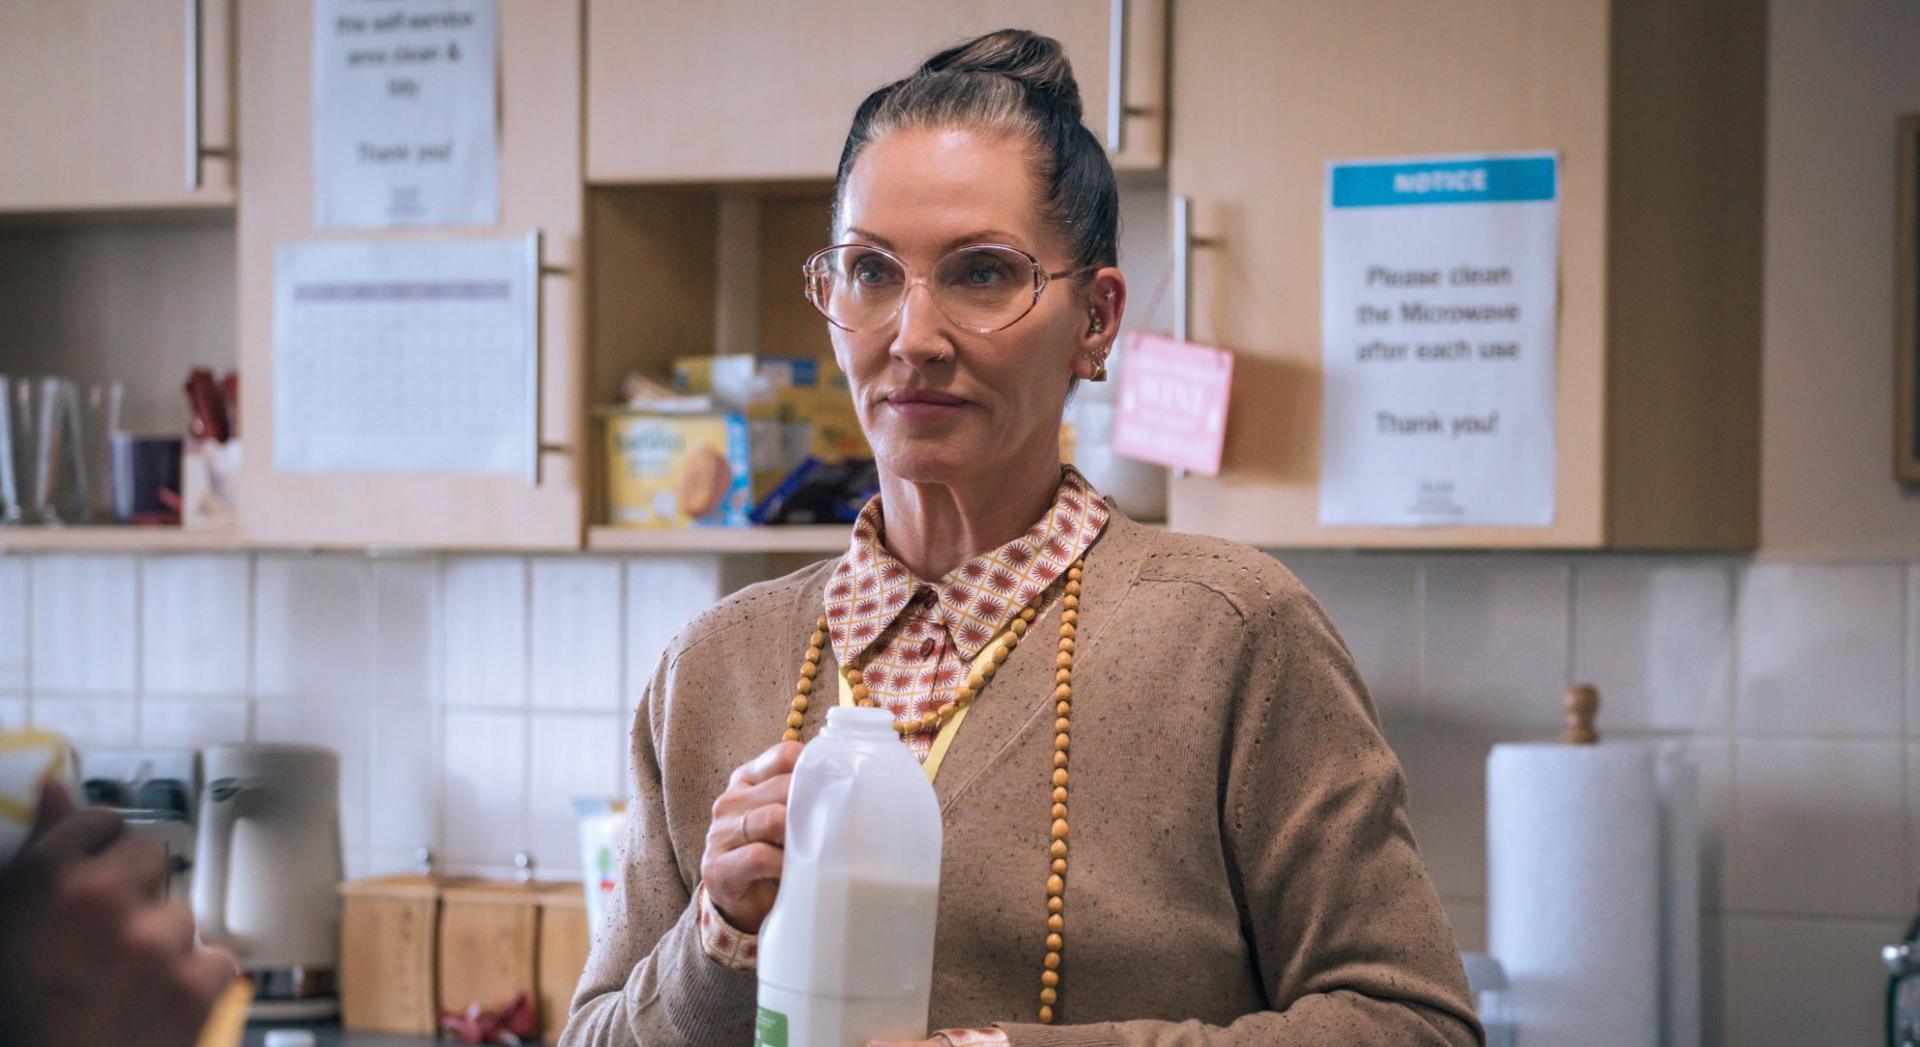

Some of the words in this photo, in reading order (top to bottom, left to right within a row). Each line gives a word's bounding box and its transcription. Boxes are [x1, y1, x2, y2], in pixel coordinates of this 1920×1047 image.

[1393, 169, 1488, 194] NOTICE
[1366, 265, 1440, 288] Please
[1449, 264, 1512, 288] clean
[1356, 304, 1393, 325] the
[1401, 301, 1520, 325] Microwave
[1356, 339, 1409, 362] after
[1415, 339, 1473, 361] each
[1478, 341, 1520, 361] use
[1375, 411, 1445, 436] Thank
[1450, 411, 1501, 440] you!
